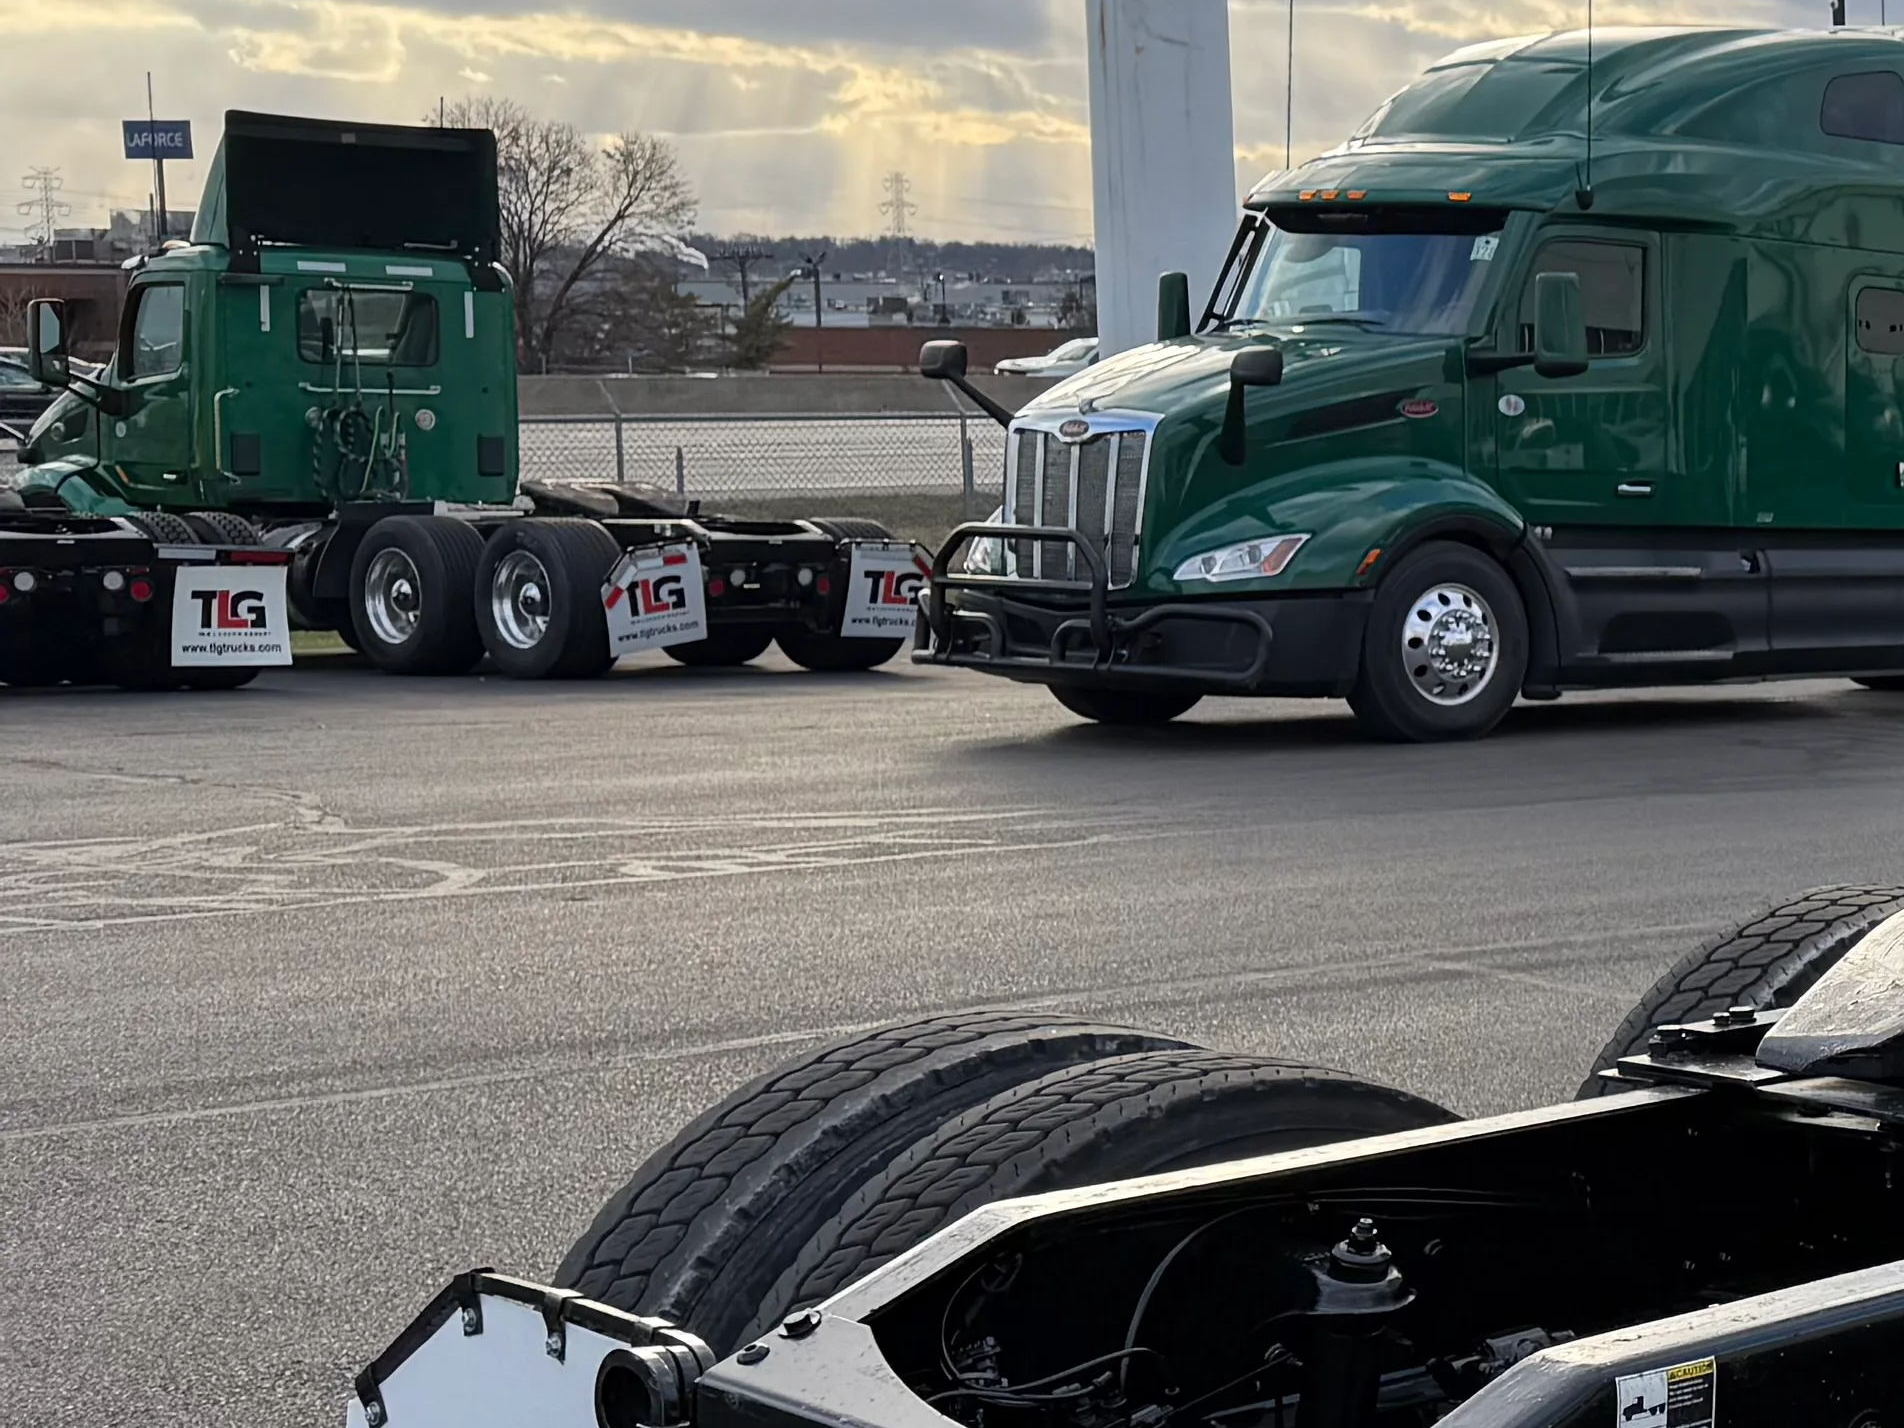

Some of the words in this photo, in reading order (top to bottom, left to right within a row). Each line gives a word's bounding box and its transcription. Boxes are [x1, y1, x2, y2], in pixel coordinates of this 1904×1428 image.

[627, 575, 687, 618] TLG
[864, 570, 924, 605] TLG
[191, 590, 267, 629] TLG
[182, 642, 282, 656] www.tlgtrucks.com
[1676, 1361, 1713, 1379] CAUTION
